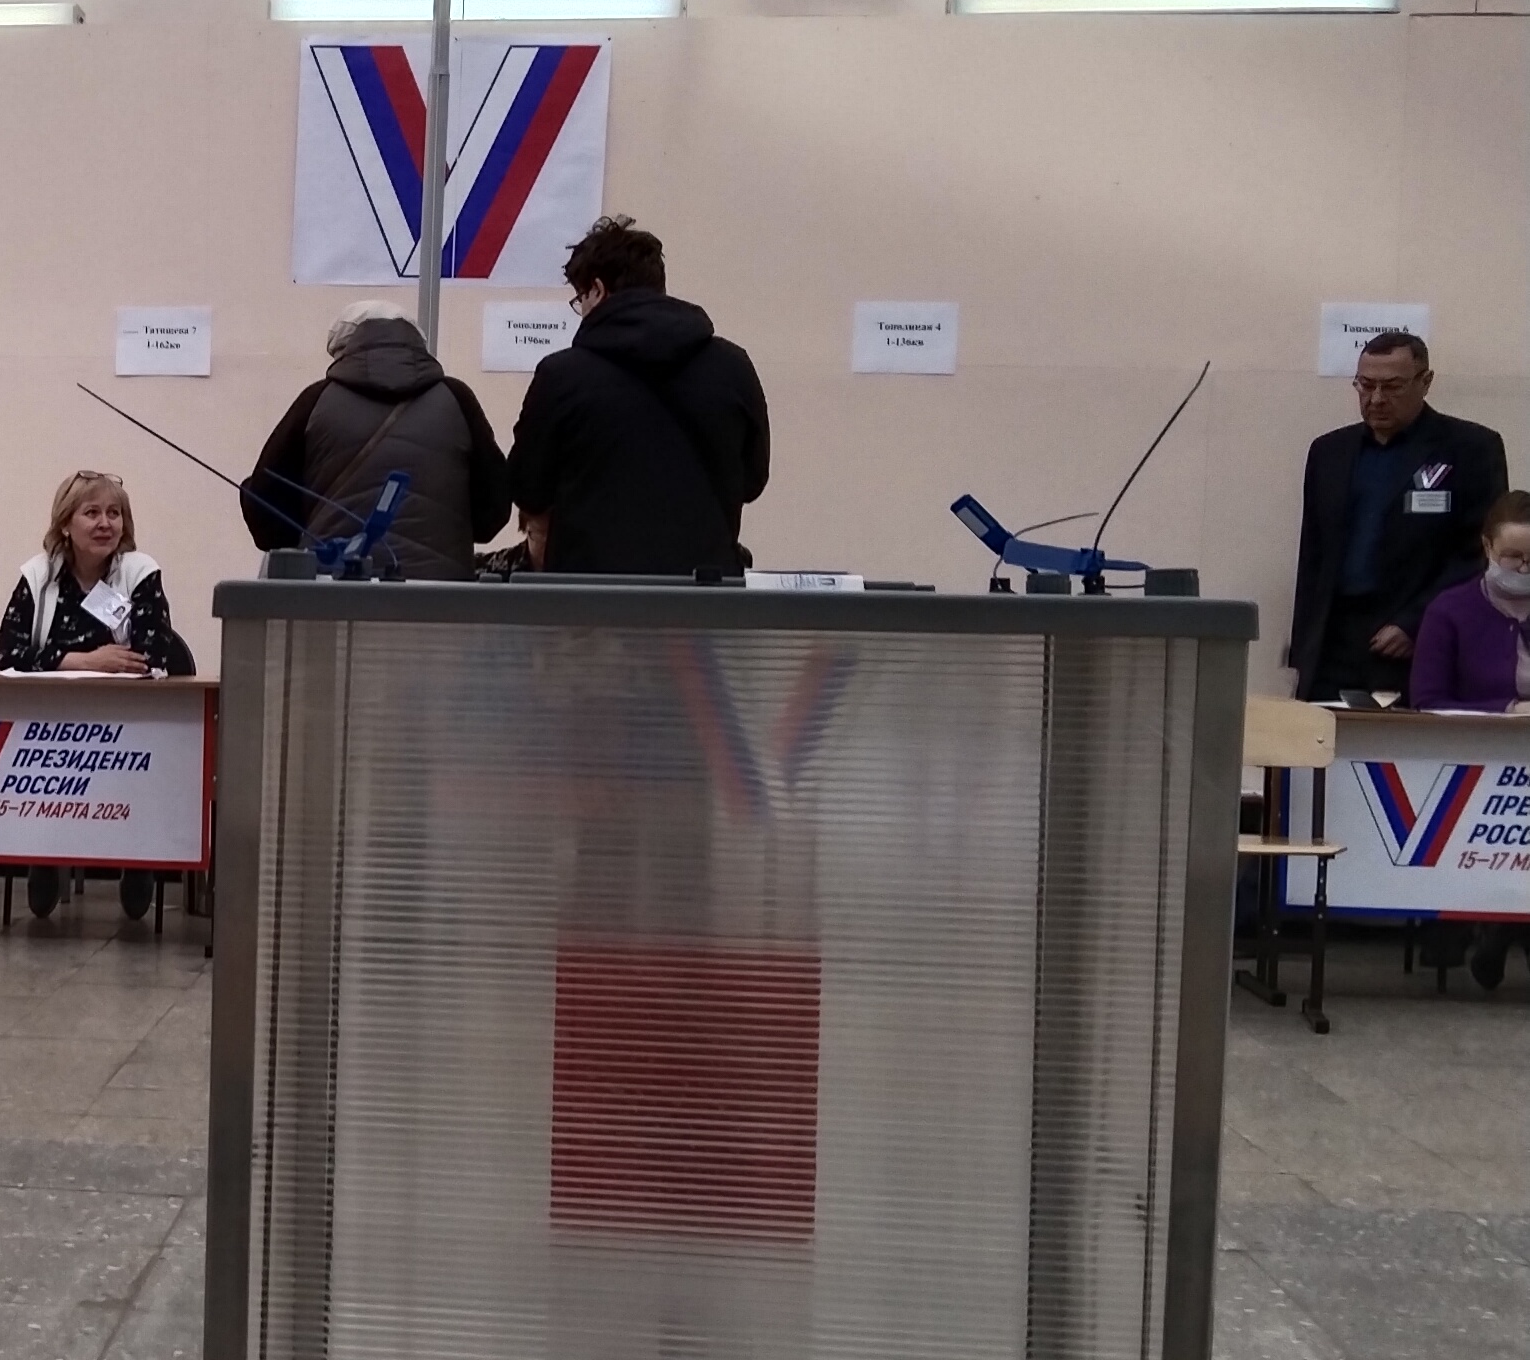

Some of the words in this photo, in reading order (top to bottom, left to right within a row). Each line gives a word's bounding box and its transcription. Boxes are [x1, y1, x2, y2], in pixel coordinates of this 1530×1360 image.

[191, 326, 197, 335] 7
[561, 321, 567, 330] 2
[935, 322, 941, 331] 4
[23, 721, 124, 744] ВЫБОРЫ
[11, 748, 152, 773] ПРЕЗИДЕНТА
[0, 774, 91, 796] РОССИИ
[36, 801, 91, 820] МАРТА
[91, 802, 131, 821] 2024
